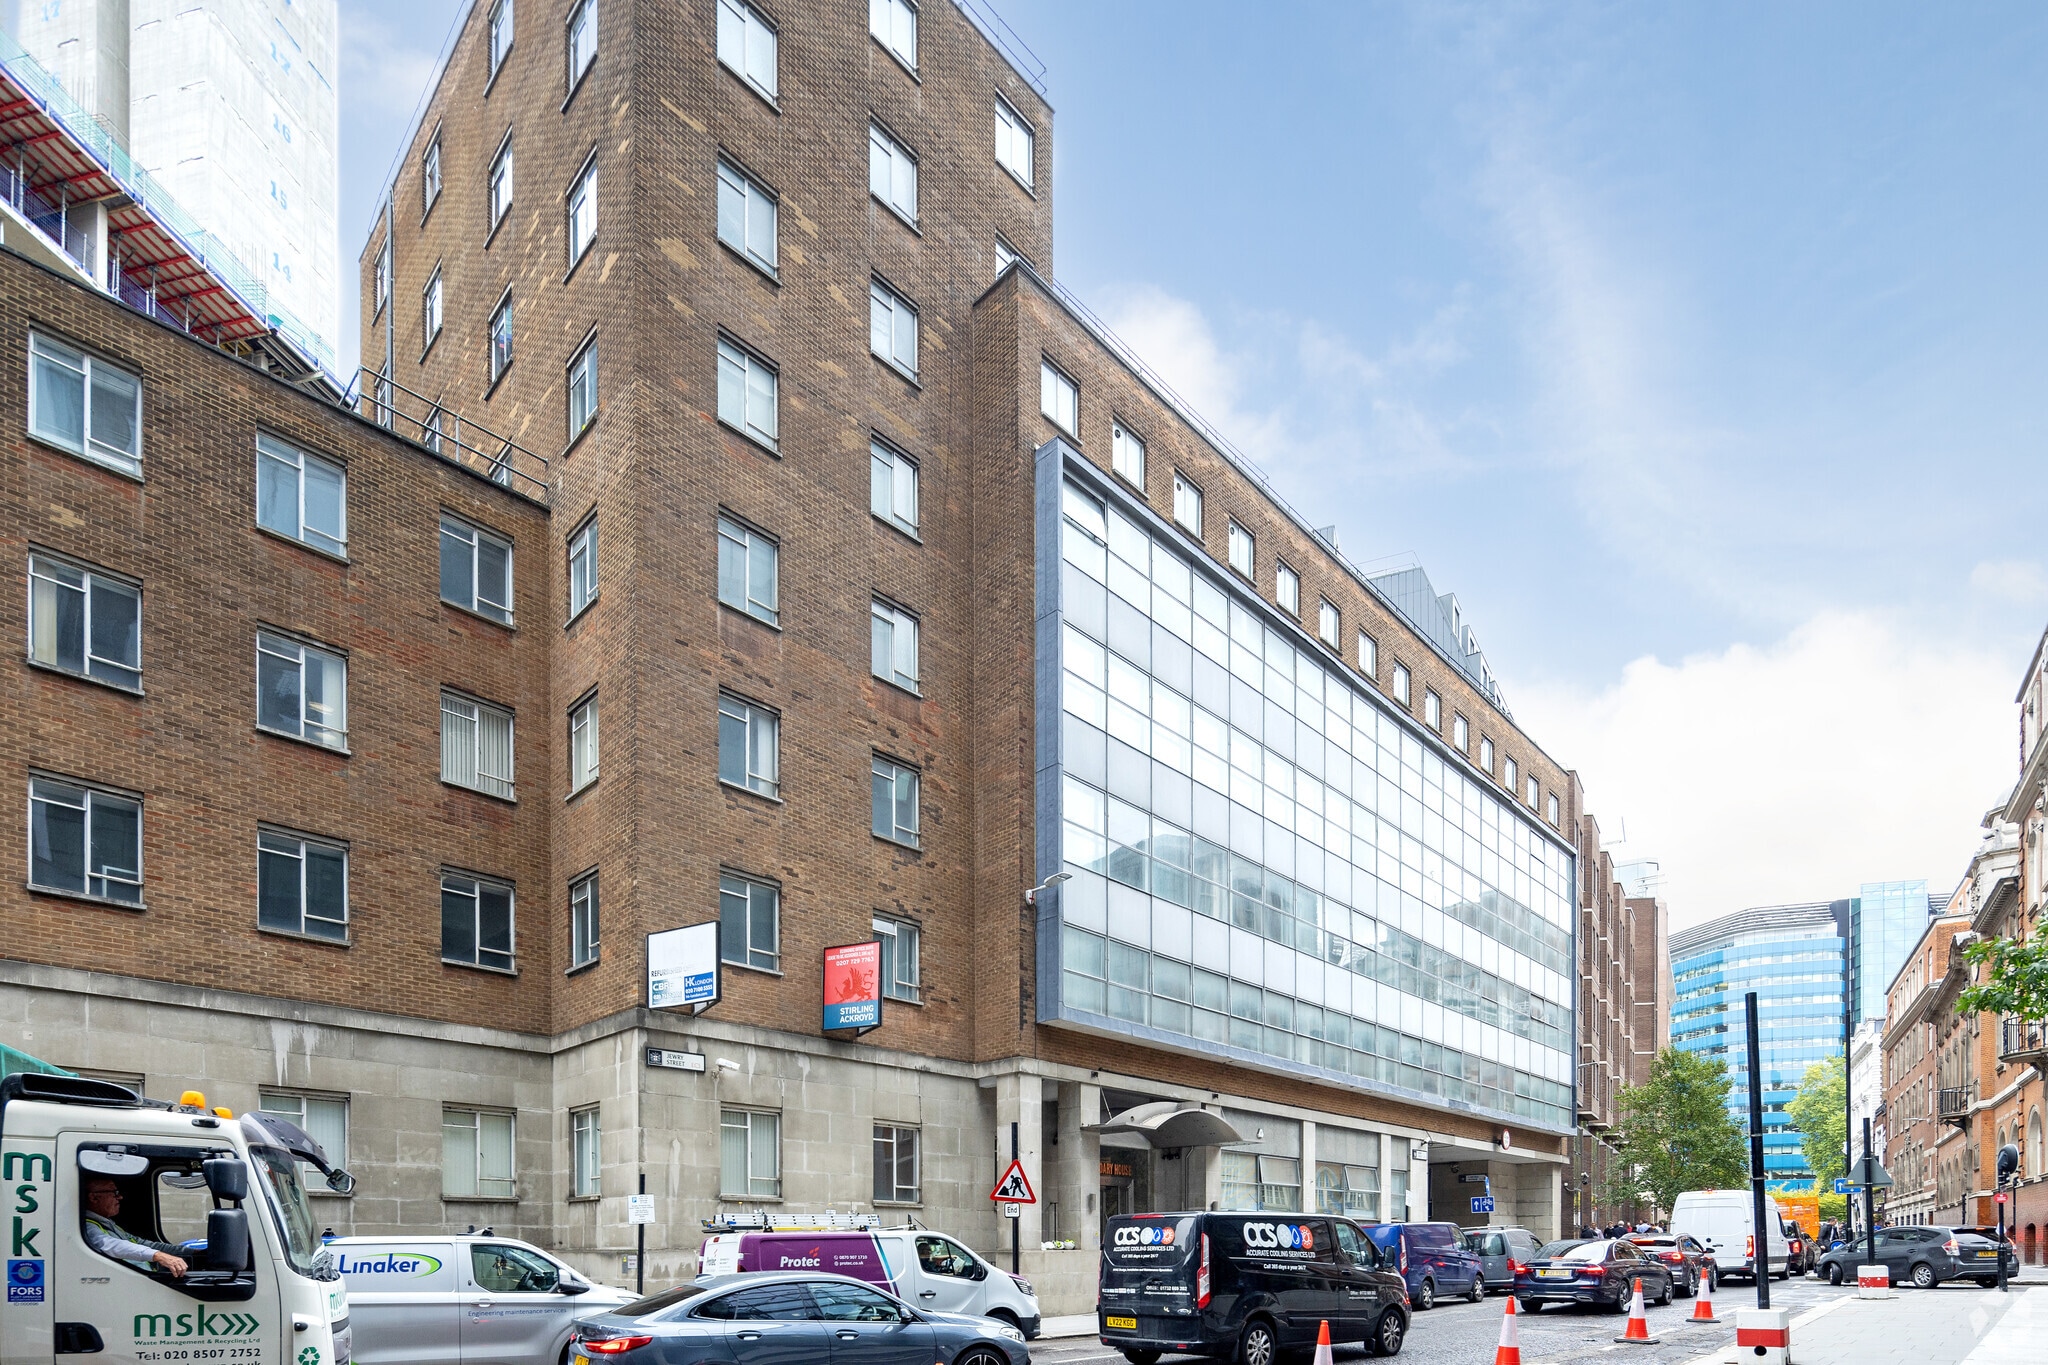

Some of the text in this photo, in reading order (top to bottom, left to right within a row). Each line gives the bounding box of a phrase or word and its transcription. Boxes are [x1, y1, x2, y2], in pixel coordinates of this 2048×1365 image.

[270, 41, 291, 76] 17
[272, 112, 291, 144] 16
[270, 180, 288, 210] 15
[272, 252, 292, 283] 14
[840, 1004, 874, 1015] STIRLING
[840, 1013, 874, 1023] ACKROYD
[1114, 1164, 1132, 1176] HOUSE
[4, 1152, 52, 1256] msk
[780, 1256, 820, 1267] Protec
[10, 1287, 42, 1296] FORS
[1109, 1318, 1122, 1326] LV22
[136, 1348, 261, 1360] Tel: 020 8507 2752
